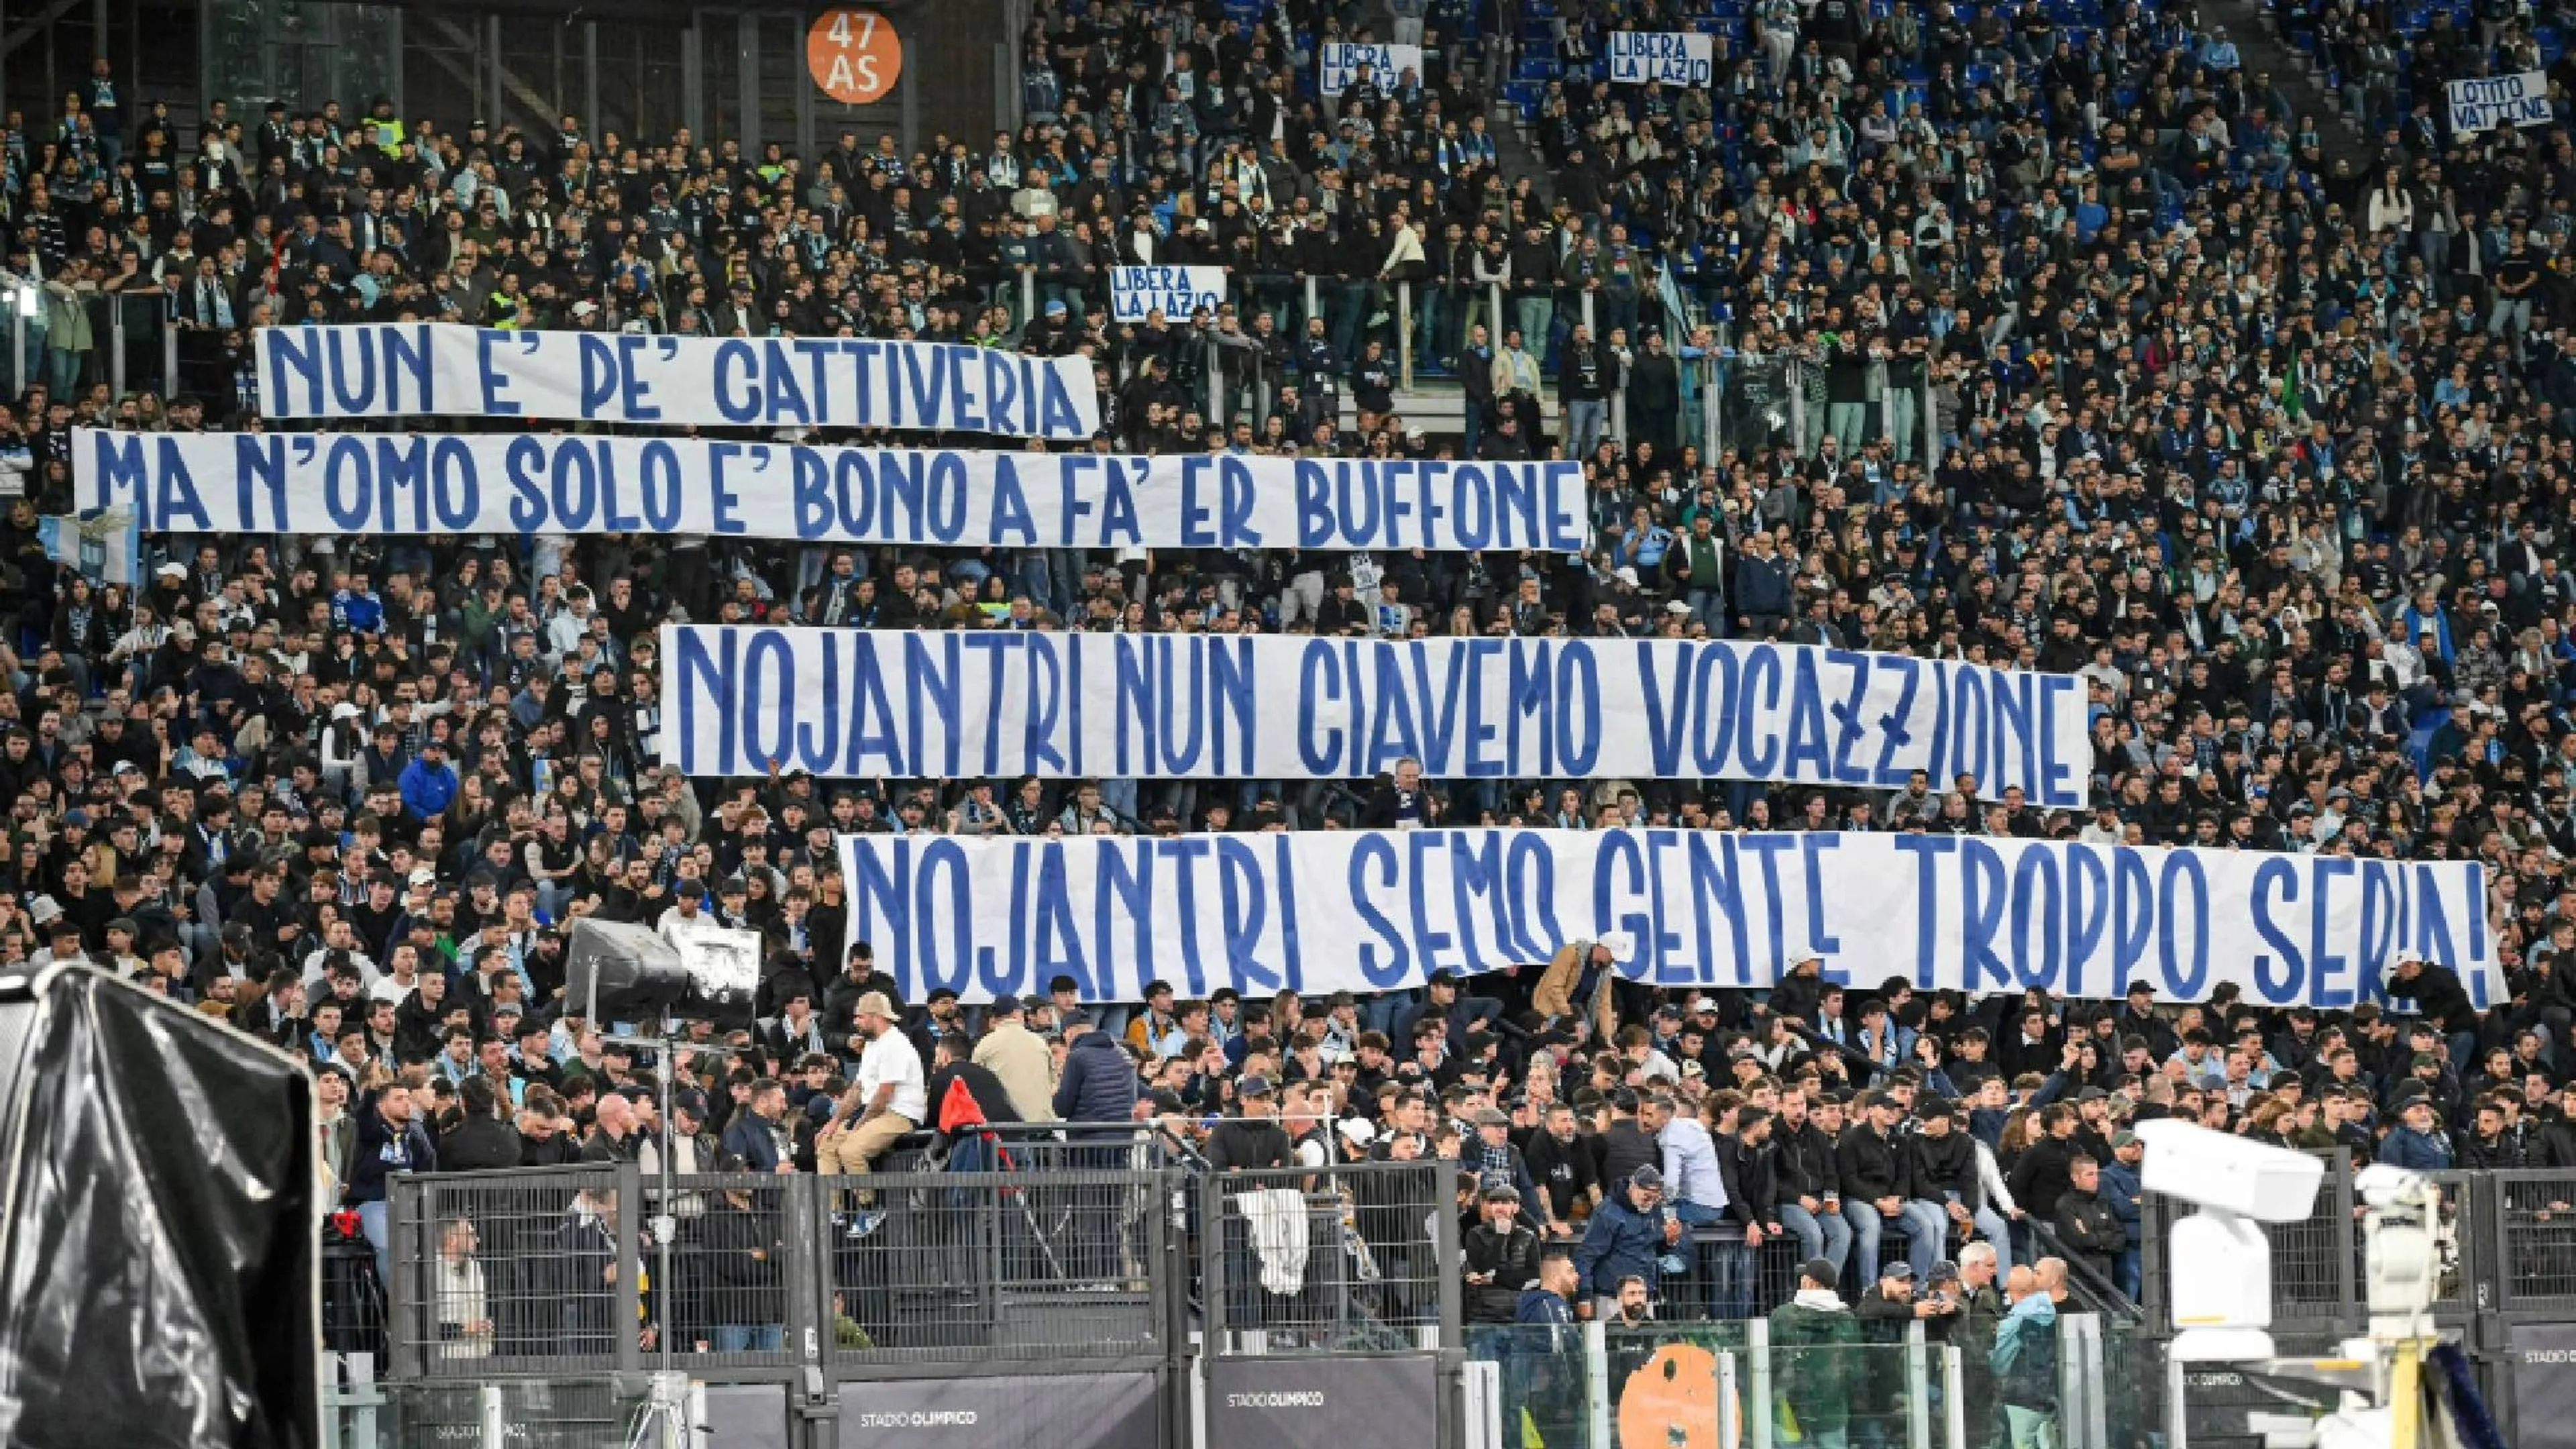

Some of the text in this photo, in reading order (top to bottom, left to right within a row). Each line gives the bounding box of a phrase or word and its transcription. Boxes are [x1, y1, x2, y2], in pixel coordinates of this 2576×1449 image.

[828, 13, 875, 48] 47
[1324, 44, 1392, 70] LIBERA
[1613, 32, 1686, 58] LIBERA
[826, 54, 879, 92] AS
[1614, 58, 1638, 77] LA
[2451, 76, 2522, 104] LOTITO
[1113, 266, 1191, 290] LIBERA
[1116, 292, 1143, 316] LA
[270, 326, 433, 417] NUN
[714, 339, 1082, 436] CATTIVERIA
[95, 431, 211, 529] MA
[506, 435, 682, 535] SOLO
[792, 446, 967, 543] BONO
[989, 455, 1037, 545] A
[1181, 457, 1261, 547] ER
[1295, 460, 1581, 550] BUFFONE
[677, 628, 2080, 806] NOJANTRI NUN CIAVEMO VOCAZZIONE
[853, 828, 2488, 1010] NOJANTRI SEMO GENTE TROPPO SERIA!
[861, 1411, 977, 1428] STADIO OLIMPICO
